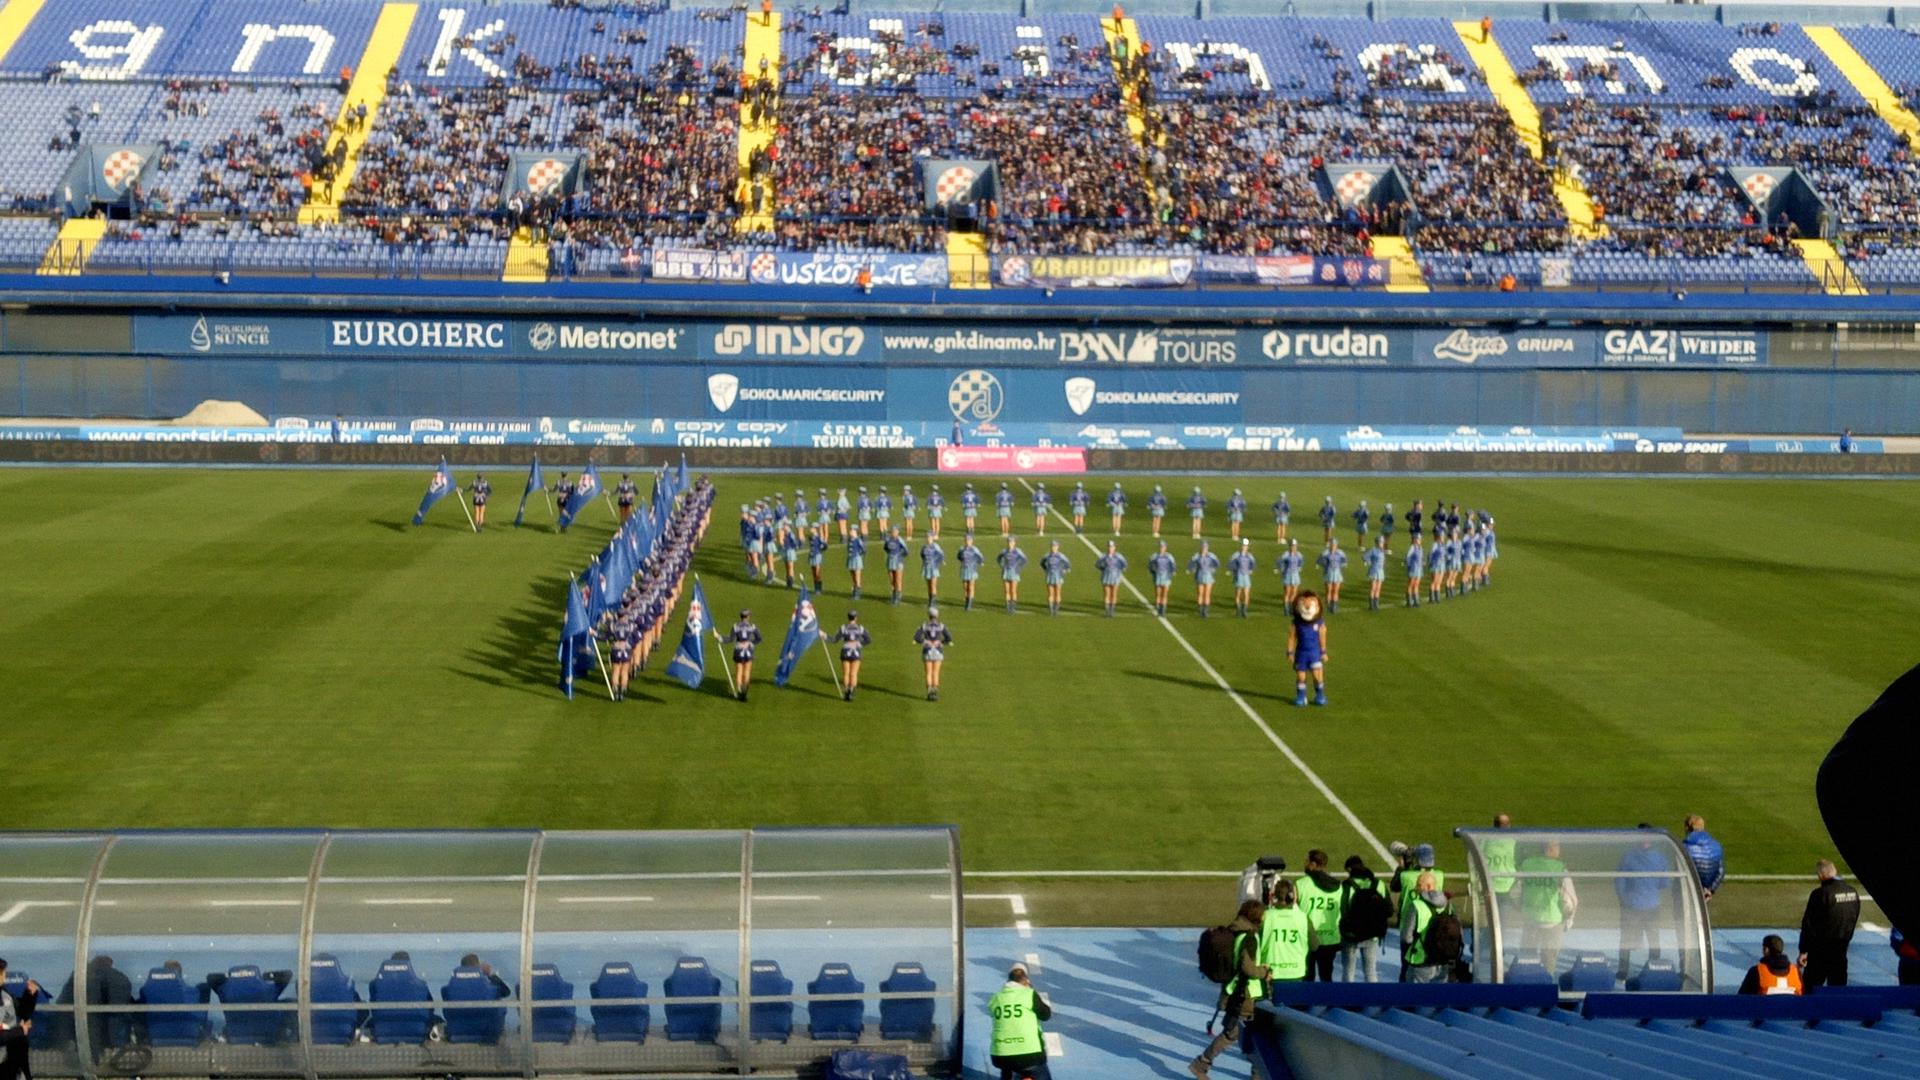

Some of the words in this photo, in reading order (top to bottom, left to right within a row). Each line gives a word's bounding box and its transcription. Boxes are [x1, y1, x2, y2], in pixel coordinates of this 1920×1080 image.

[214, 334, 270, 346] SUNCE
[332, 321, 504, 349] EUROHERC
[560, 326, 677, 350] Metronet
[884, 330, 1057, 353] www.gnkdinamo.hr
[1295, 328, 1388, 357] rudan
[1604, 330, 1669, 355] GAZ
[1159, 342, 1237, 364] TOURS
[1517, 338, 1574, 353] GRUPA
[1680, 337, 1757, 355] WEIDER
[87, 429, 362, 444] wwwsportski-marketinghr
[1347, 438, 1607, 453] wwwsportski-marketinghr
[1684, 442, 1728, 454] SPORT
[1309, 897, 1335, 912] 125
[1273, 928, 1299, 945] 113
[993, 1004, 1023, 1021] 055
